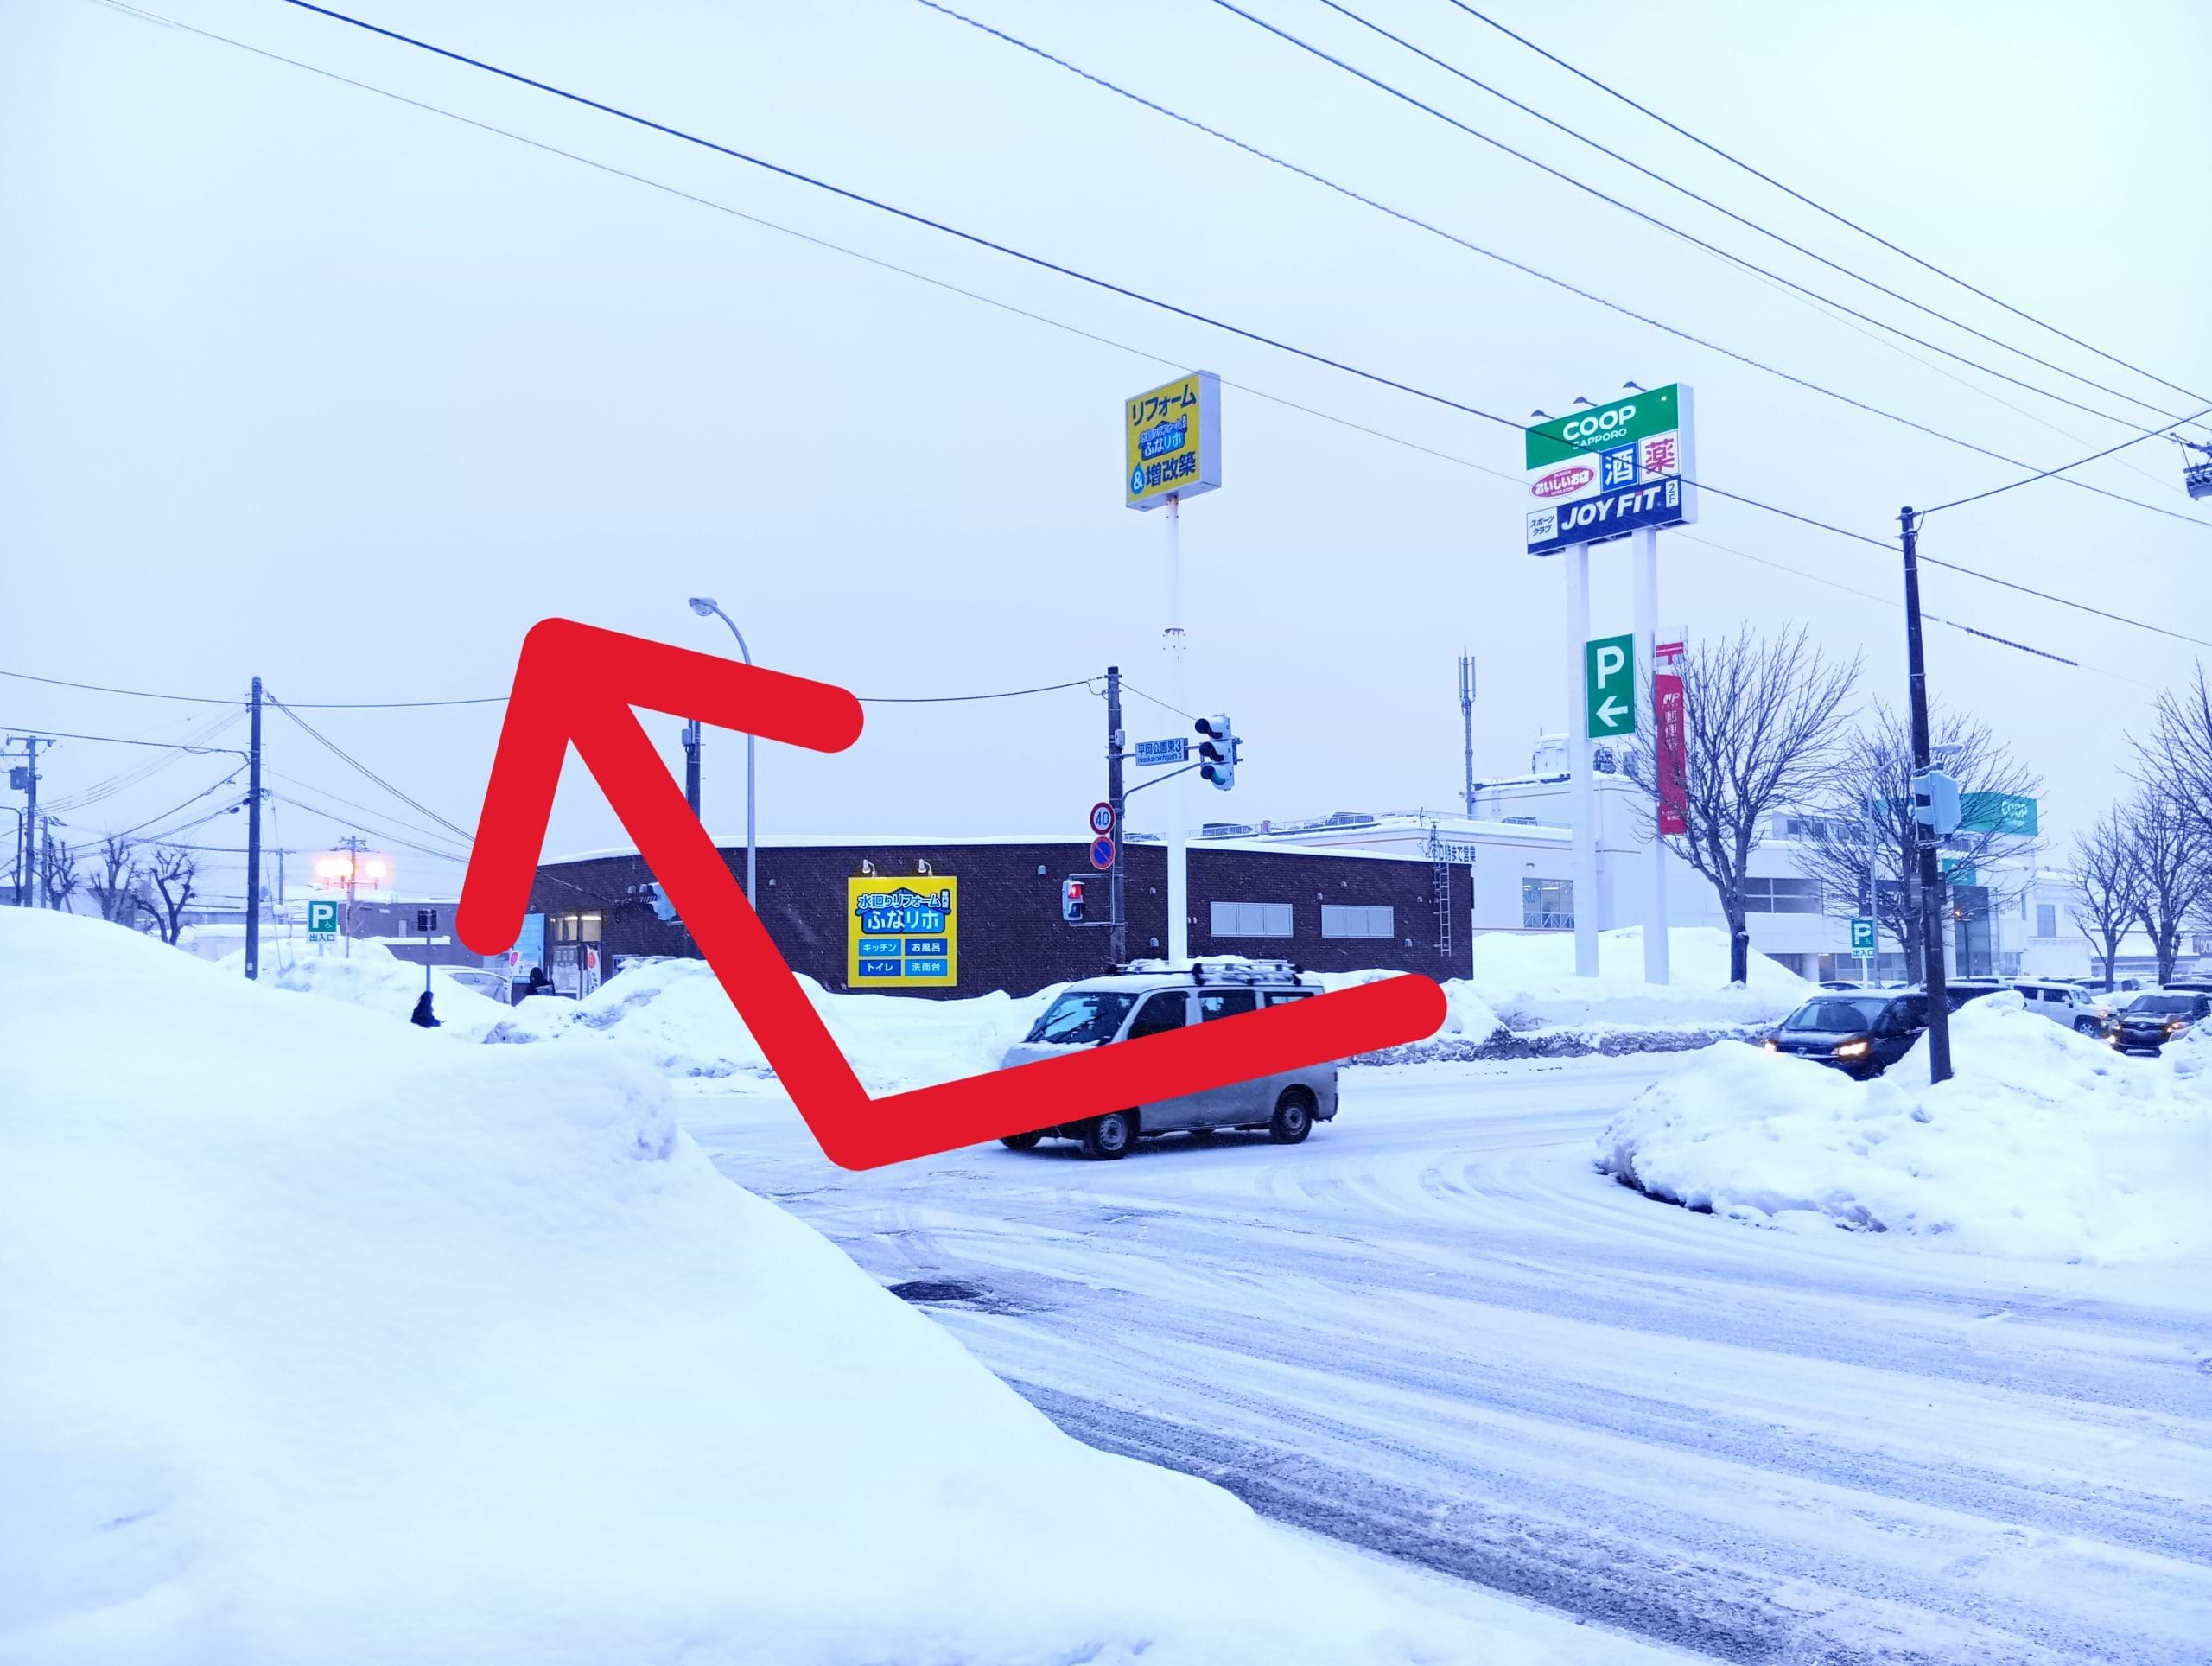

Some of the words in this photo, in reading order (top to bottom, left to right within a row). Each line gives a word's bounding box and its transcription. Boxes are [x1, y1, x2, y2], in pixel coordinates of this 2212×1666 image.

[1132, 384, 1196, 426] リフォーム
[1562, 404, 1637, 440] COOP
[1573, 428, 1627, 449] SAPPORO
[1644, 438, 1675, 474] 薬
[1146, 451, 1196, 487] 増改築
[1605, 448, 1634, 485] 酒
[1529, 515, 1554, 528] スポーツ
[1532, 525, 1551, 537] クラブ
[1596, 645, 1625, 690] P
[1095, 811, 1109, 826] 40
[858, 893, 941, 909] 水廻りリフォーム
[312, 904, 334, 929] P
[868, 910, 939, 930] ふなリホ
[309, 933, 335, 942] 出入口
[1853, 923, 1872, 945] P
[863, 943, 897, 952] キッチン
[912, 943, 941, 952] お風呂
[868, 963, 893, 973] トイレ
[912, 962, 941, 972] 洗面台
